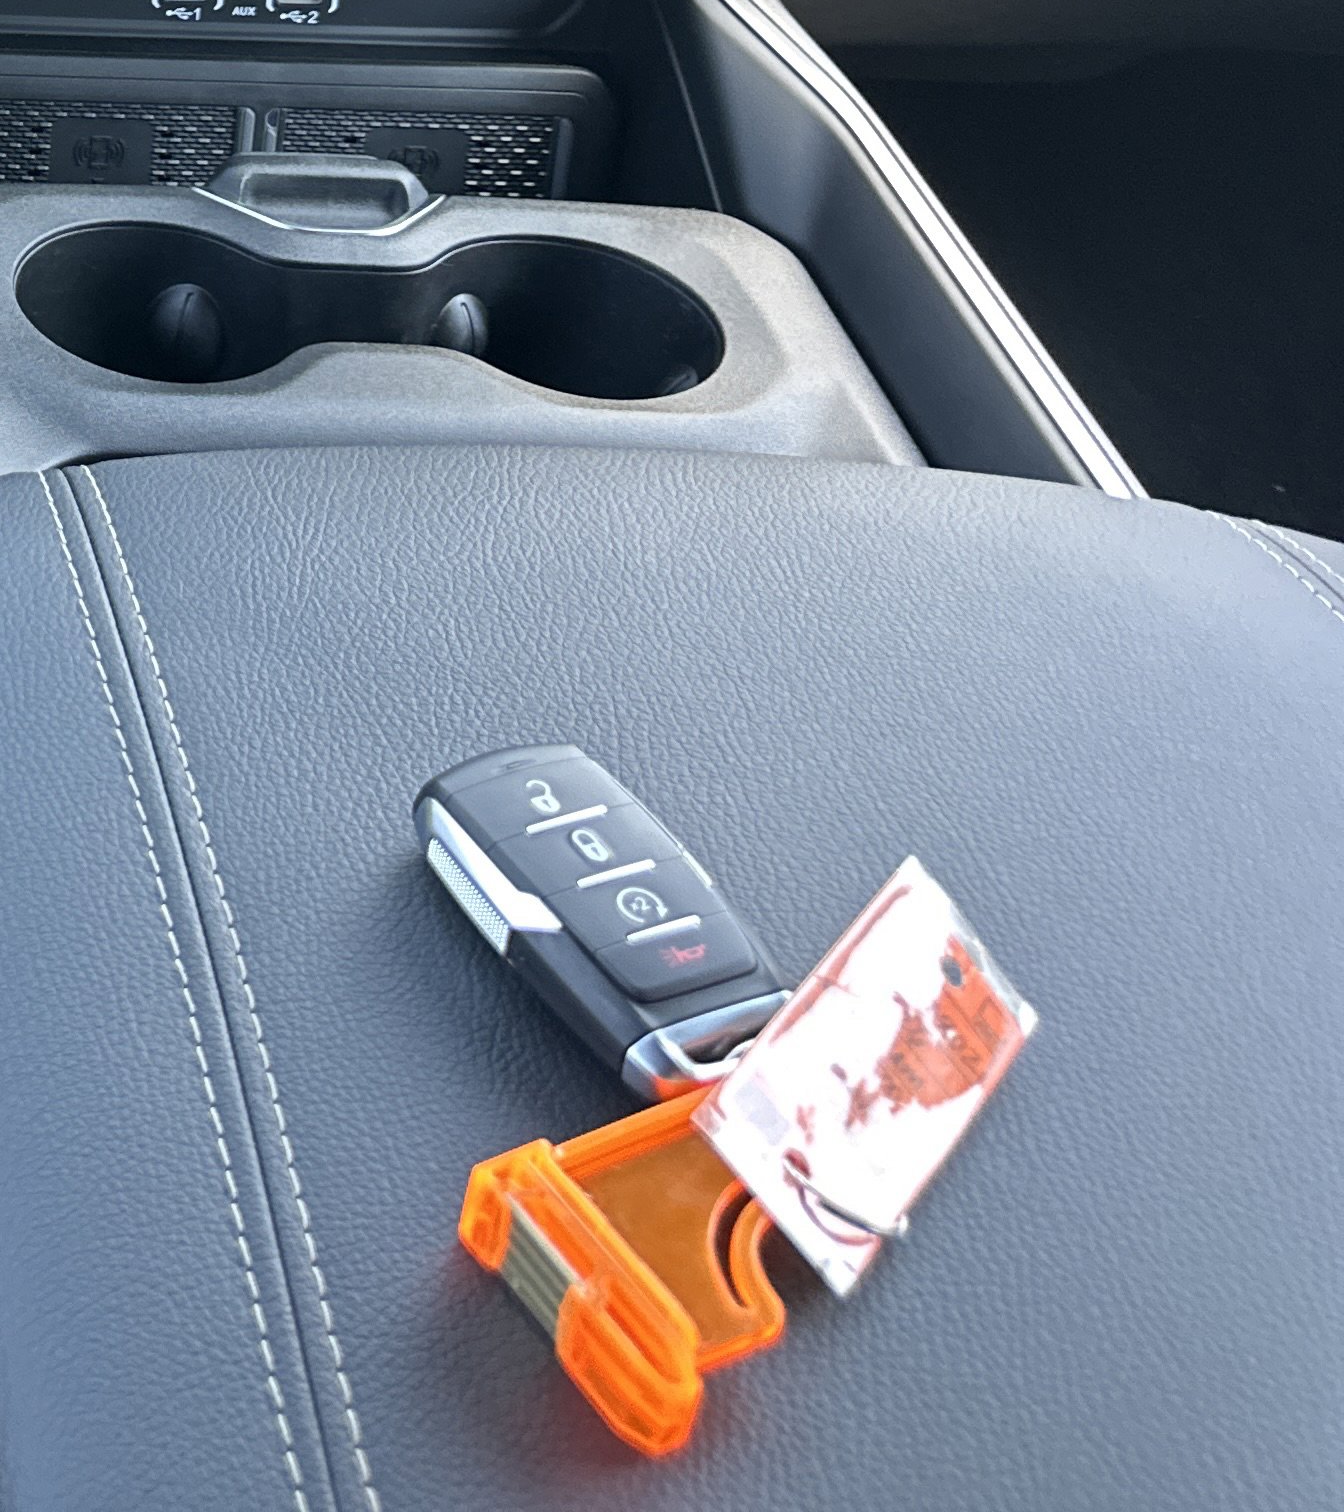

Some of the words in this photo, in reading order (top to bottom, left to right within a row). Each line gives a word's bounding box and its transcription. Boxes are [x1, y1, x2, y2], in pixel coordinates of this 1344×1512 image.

[193, 7, 202, 20] 1
[231, 6, 256, 17] AUX
[307, 11, 320, 23] 2
